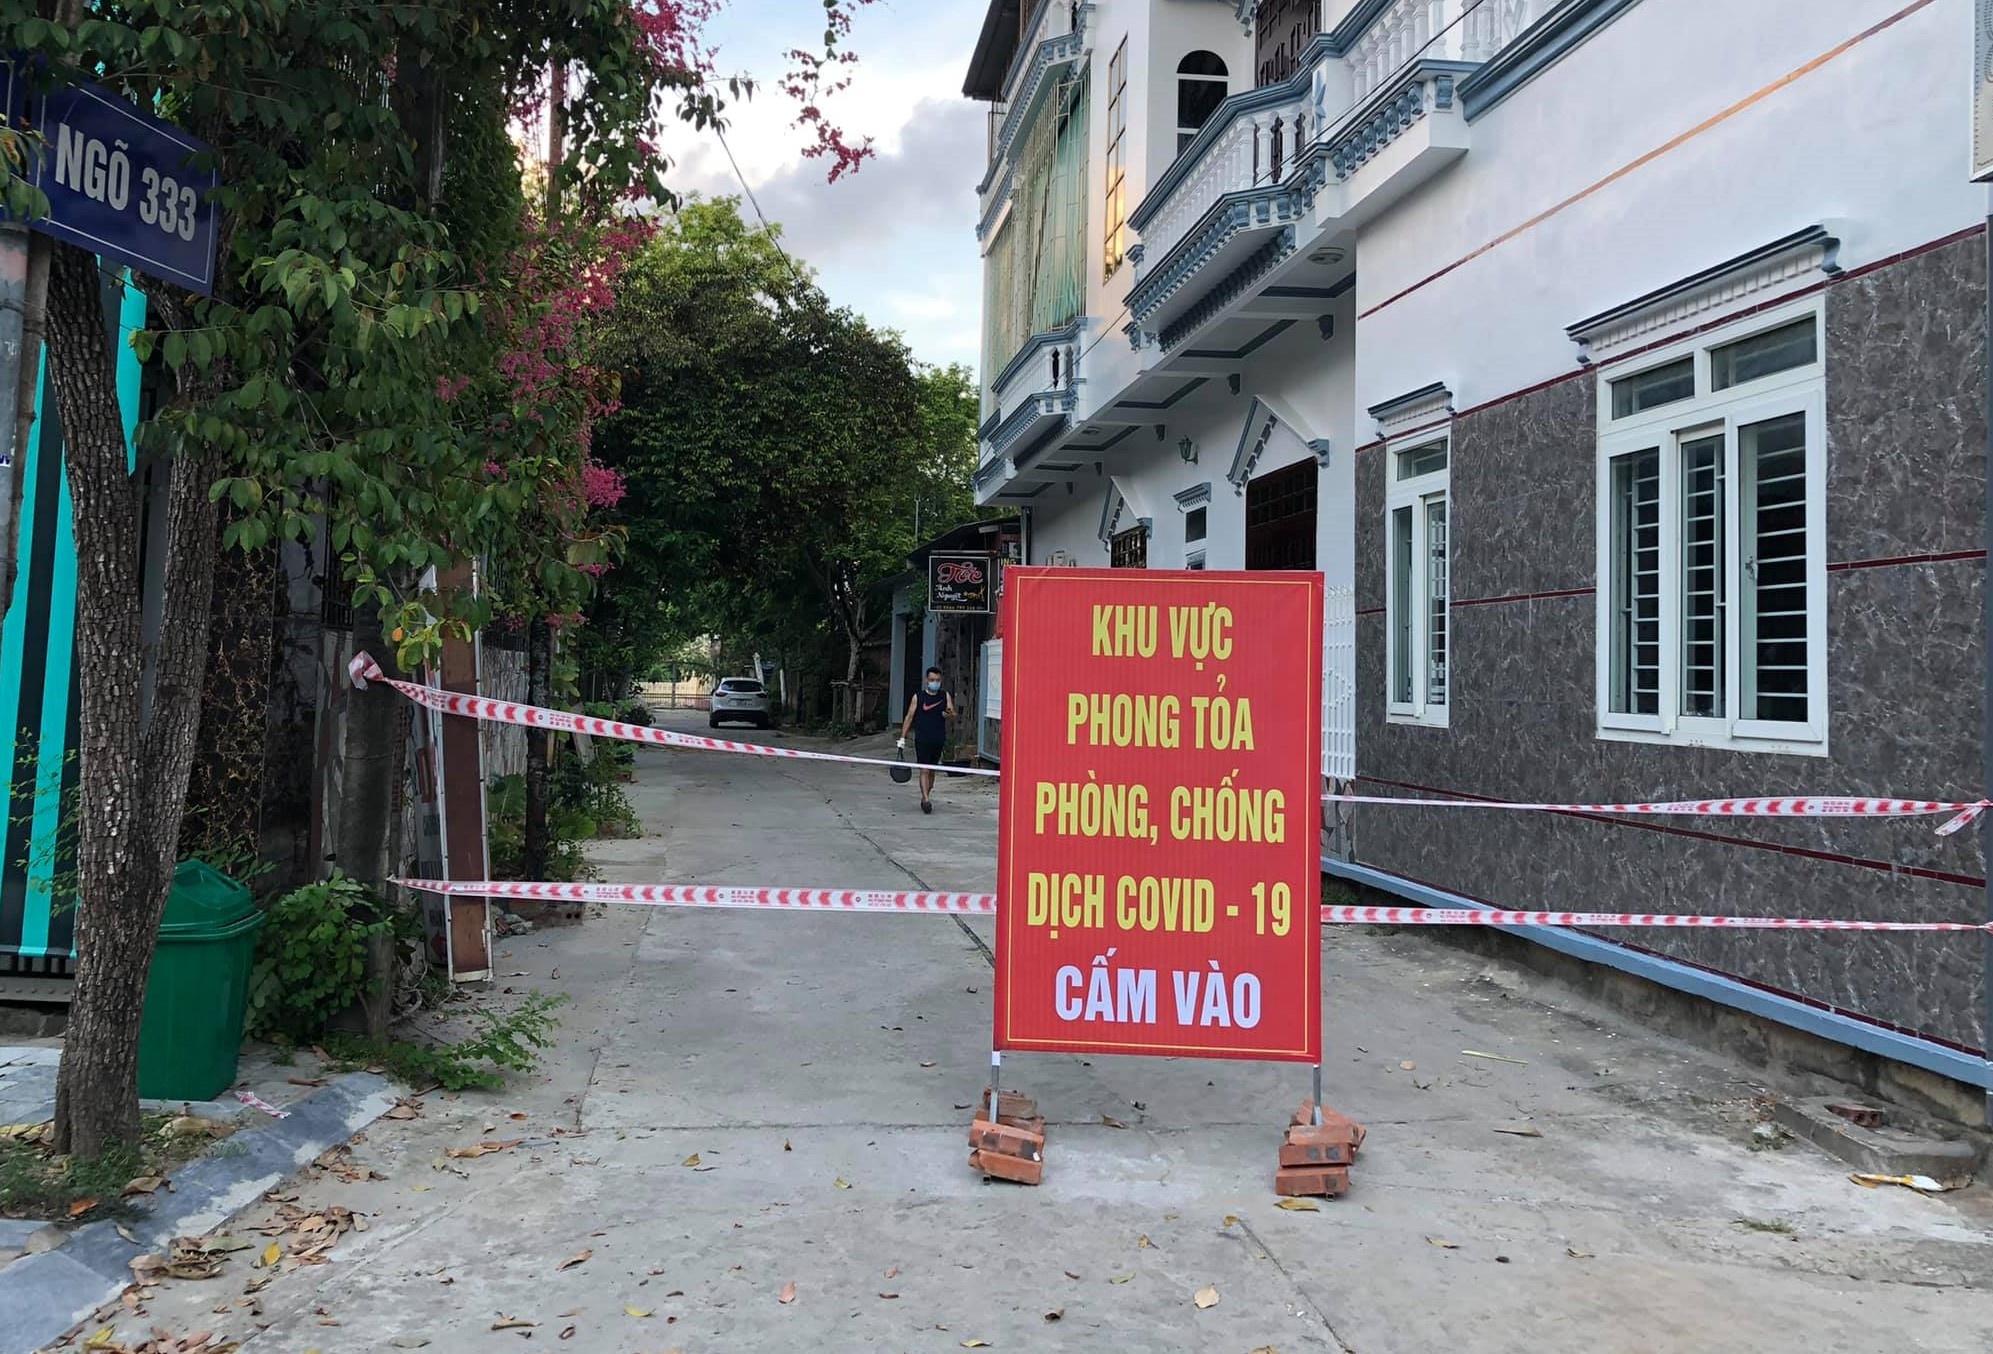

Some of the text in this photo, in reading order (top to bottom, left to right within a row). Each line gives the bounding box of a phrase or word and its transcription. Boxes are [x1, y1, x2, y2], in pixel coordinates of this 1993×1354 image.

[55, 121, 198, 242] NGÕ 333
[1091, 601, 1233, 671] KHU VỰC
[1066, 673, 1255, 751] PHONG TỎA
[1034, 768, 1285, 846] PHÒNG, CHỐNG
[1026, 872, 1105, 939] DỊCH
[1116, 875, 1215, 932] COVID
[1251, 881, 1291, 937] 19
[1054, 947, 1262, 1029] CẤM VÀO
